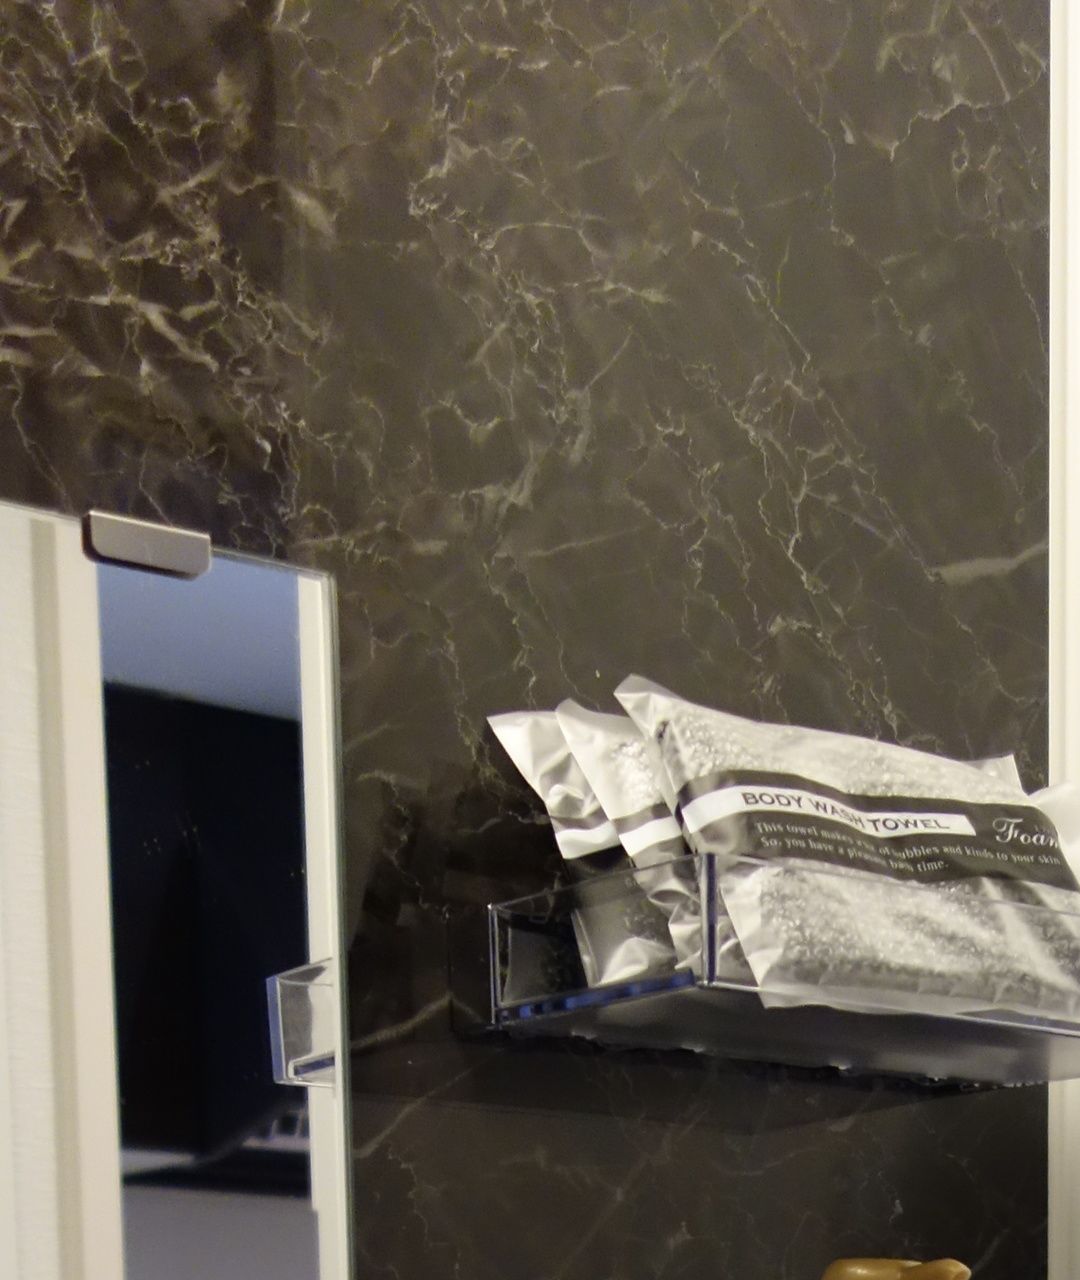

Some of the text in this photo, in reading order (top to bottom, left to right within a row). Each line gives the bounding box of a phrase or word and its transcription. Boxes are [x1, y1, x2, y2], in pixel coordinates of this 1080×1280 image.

[743, 792, 950, 833] BODY WASH TOWEL
[755, 822, 785, 834] This
[786, 824, 819, 837] towel
[943, 845, 962, 856] and
[965, 846, 994, 860] kinds
[997, 851, 1009, 862] to
[1010, 853, 1035, 864] your
[784, 839, 807, 850] you
[809, 839, 835, 852] have
